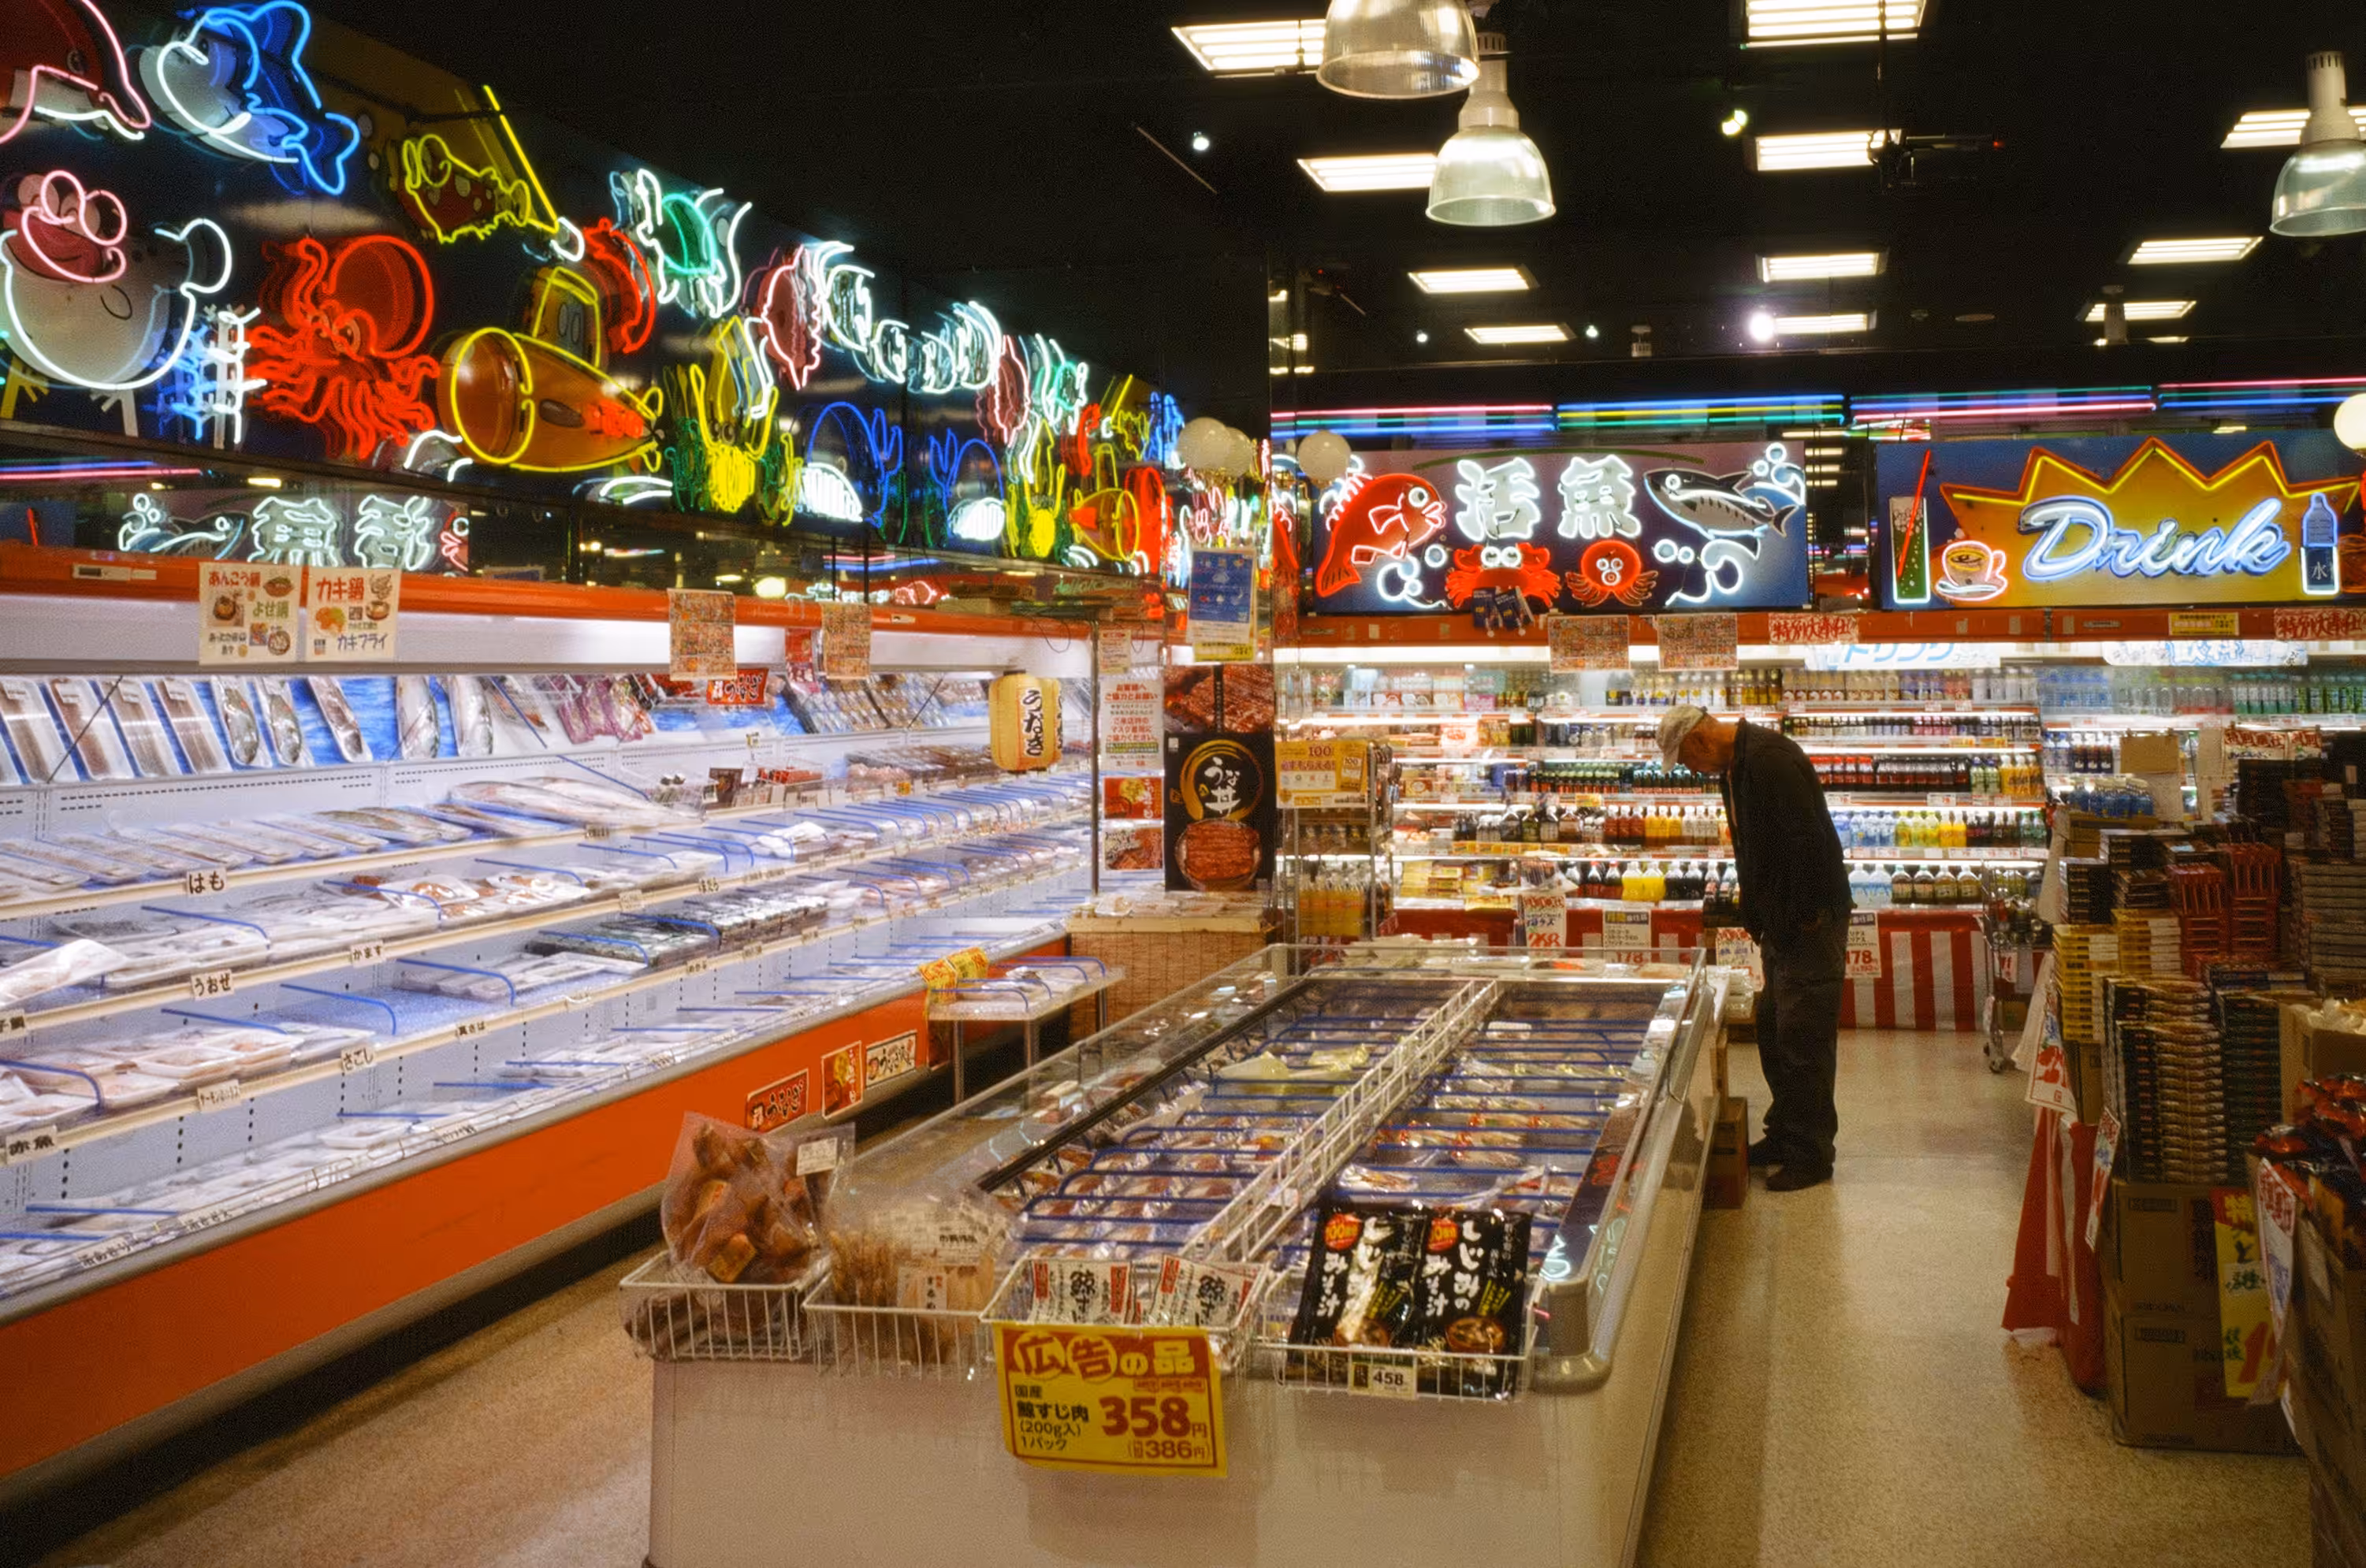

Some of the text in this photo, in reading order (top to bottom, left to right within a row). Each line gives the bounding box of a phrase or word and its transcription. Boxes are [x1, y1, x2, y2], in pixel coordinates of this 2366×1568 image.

[1455, 455, 1642, 541] 活魚
[2018, 495, 2291, 581] Drink
[2312, 561, 2327, 580] 水
[316, 577, 365, 601] カキ鍋
[337, 633, 389, 652] カキフライ
[188, 870, 225, 894] はも
[343, 1047, 374, 1071] さごし
[1453, 1220, 1485, 1311] しじみの
[1015, 1335, 1195, 1381] 広告の品
[1373, 1371, 1404, 1386] 458
[1014, 1384, 1042, 1399] 国産
